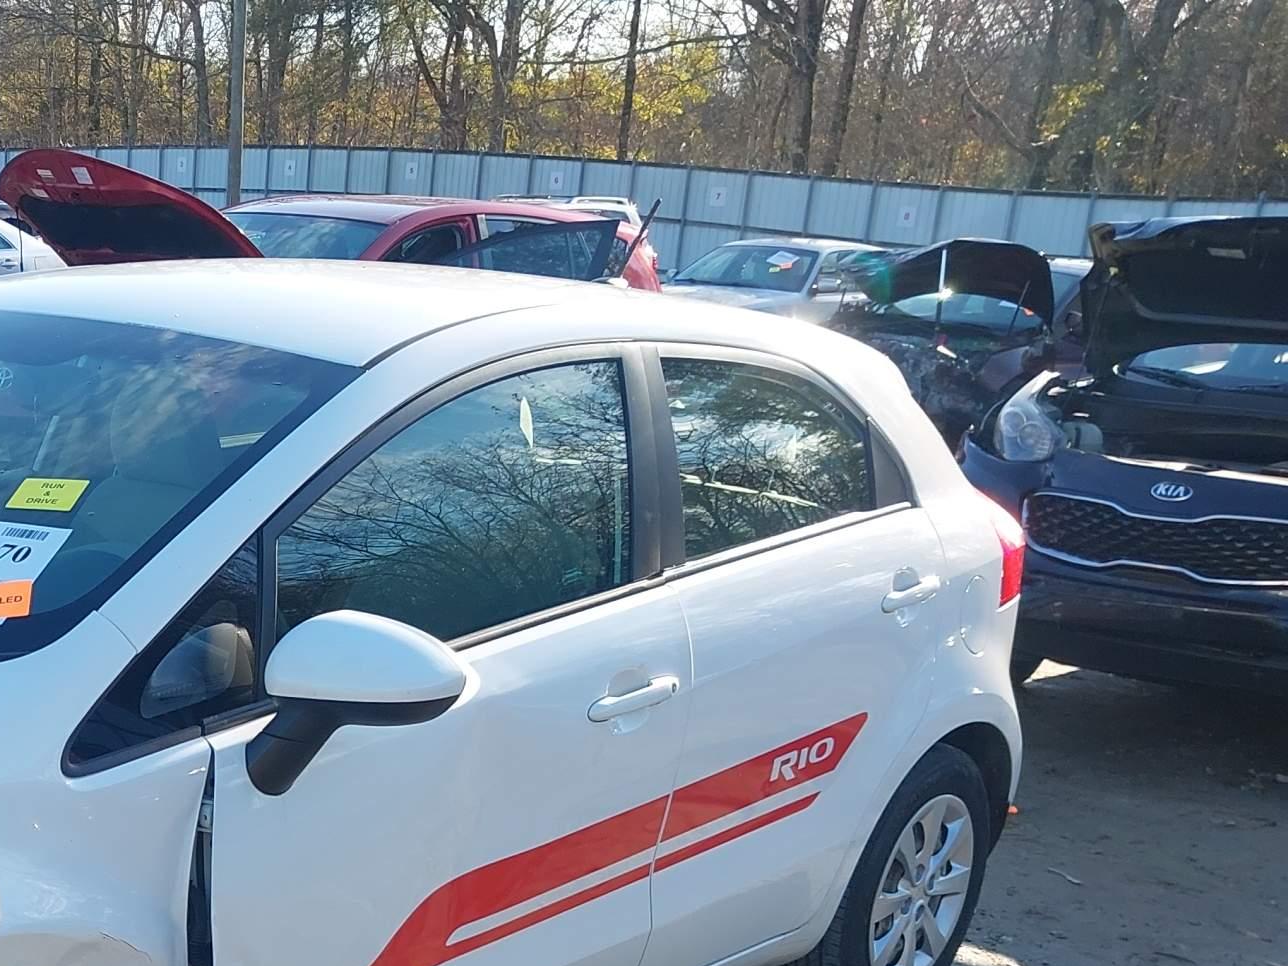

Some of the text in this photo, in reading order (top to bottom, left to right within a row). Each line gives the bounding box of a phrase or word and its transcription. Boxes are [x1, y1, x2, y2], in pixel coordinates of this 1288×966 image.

[1156, 483, 1185, 497] KIA
[25, 497, 59, 505] DRIVE
[770, 737, 834, 782] RIO
